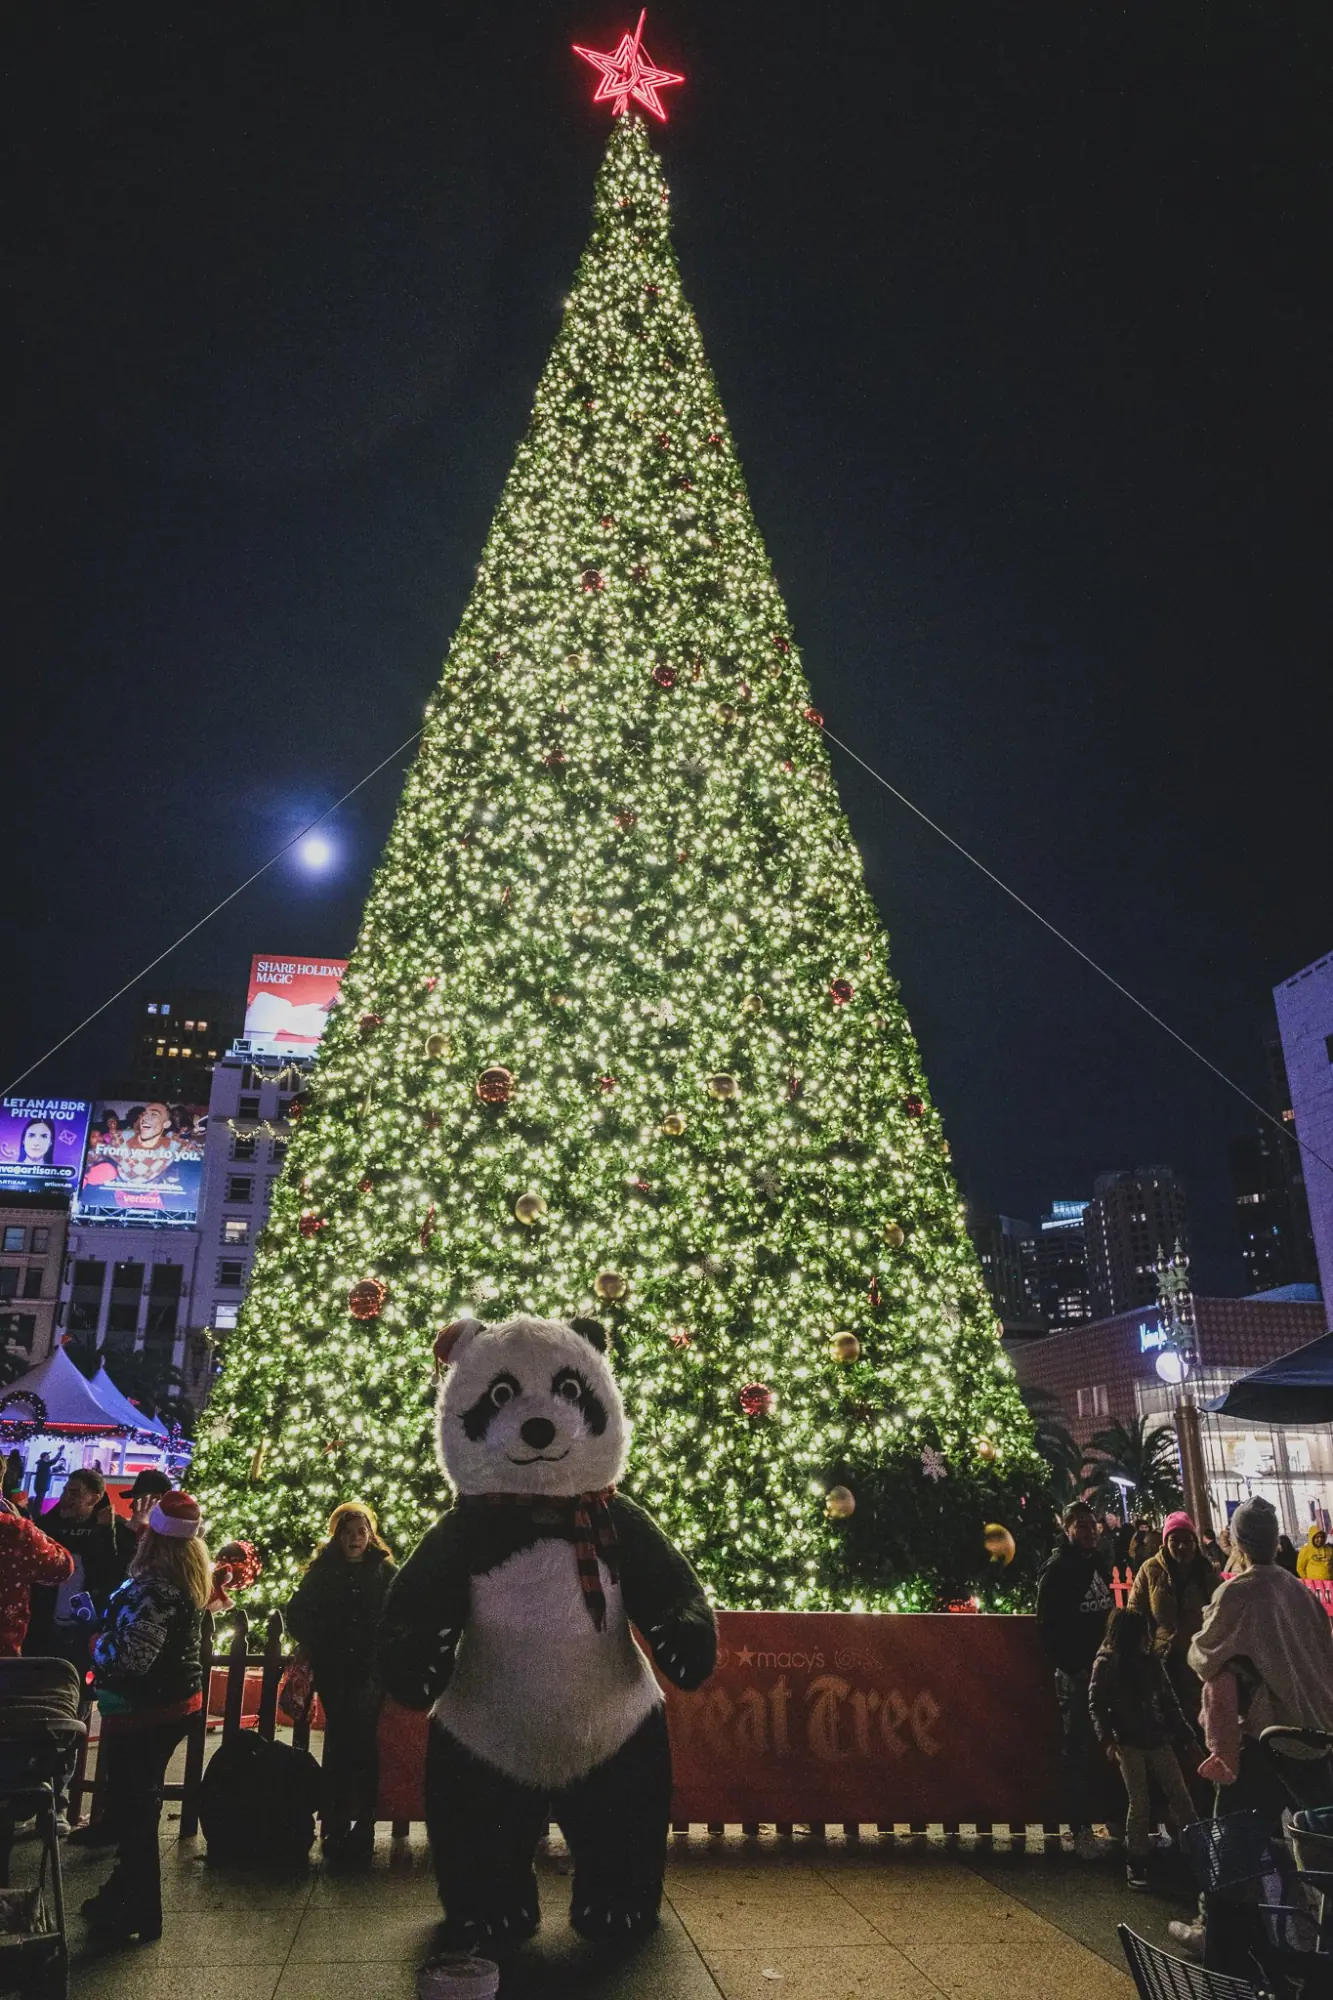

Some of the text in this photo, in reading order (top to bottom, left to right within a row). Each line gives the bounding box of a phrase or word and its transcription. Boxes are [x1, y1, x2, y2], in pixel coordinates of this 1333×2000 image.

[257, 961, 345, 977] SHARE HOLIDAY
[256, 973, 293, 984] MAGIC
[3, 1098, 86, 1111] LET AN AI BDR
[11, 1108, 75, 1120] PITCH YOU
[95, 1144, 129, 1157] From
[156, 1149, 173, 1159] to
[174, 1151, 201, 1162] you.
[123, 1194, 160, 1204] verizon
[673, 1674, 942, 1760] reat Tree
